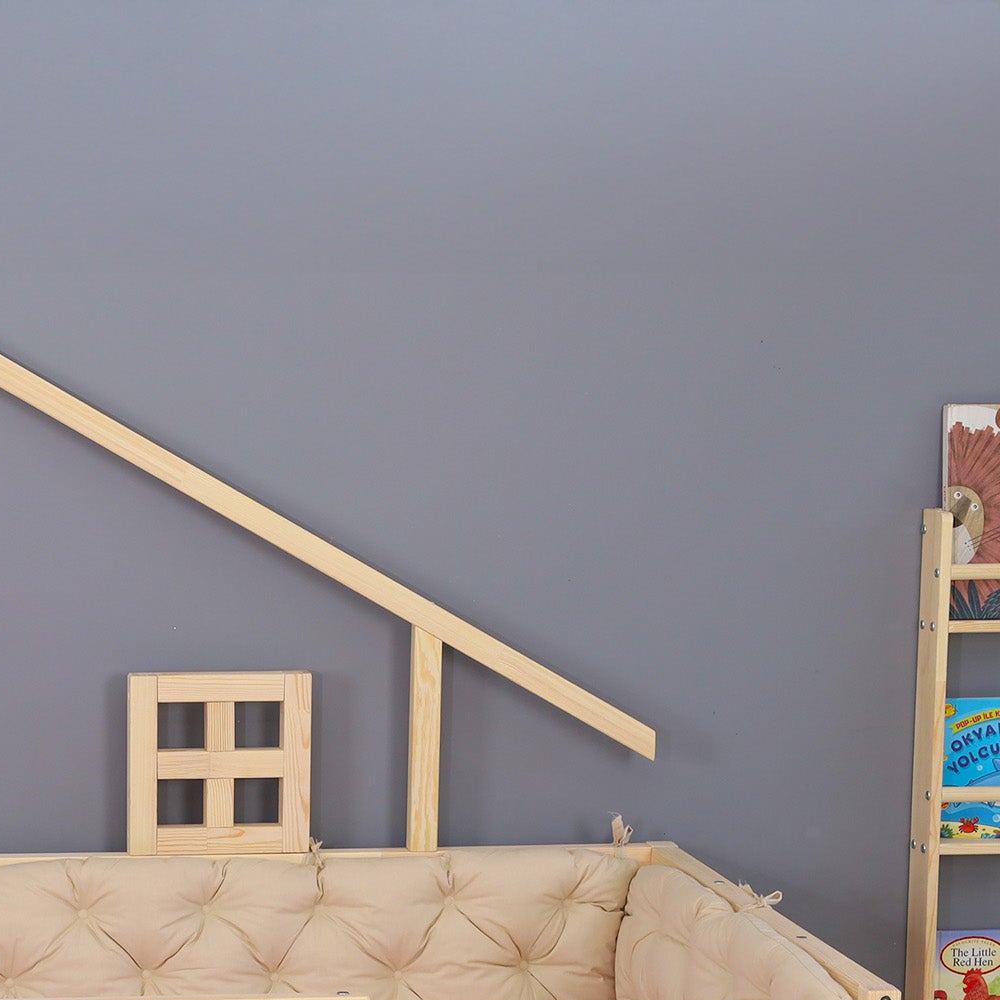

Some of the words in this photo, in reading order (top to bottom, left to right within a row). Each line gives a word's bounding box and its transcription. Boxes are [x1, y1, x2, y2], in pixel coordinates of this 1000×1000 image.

[955, 715, 982, 729] POP-UP
[947, 743, 999, 774] YOLCU
[951, 948, 969, 957] The
[972, 947, 997, 957] Little
[953, 957, 972, 967] Red
[974, 957, 993, 967] Hen
